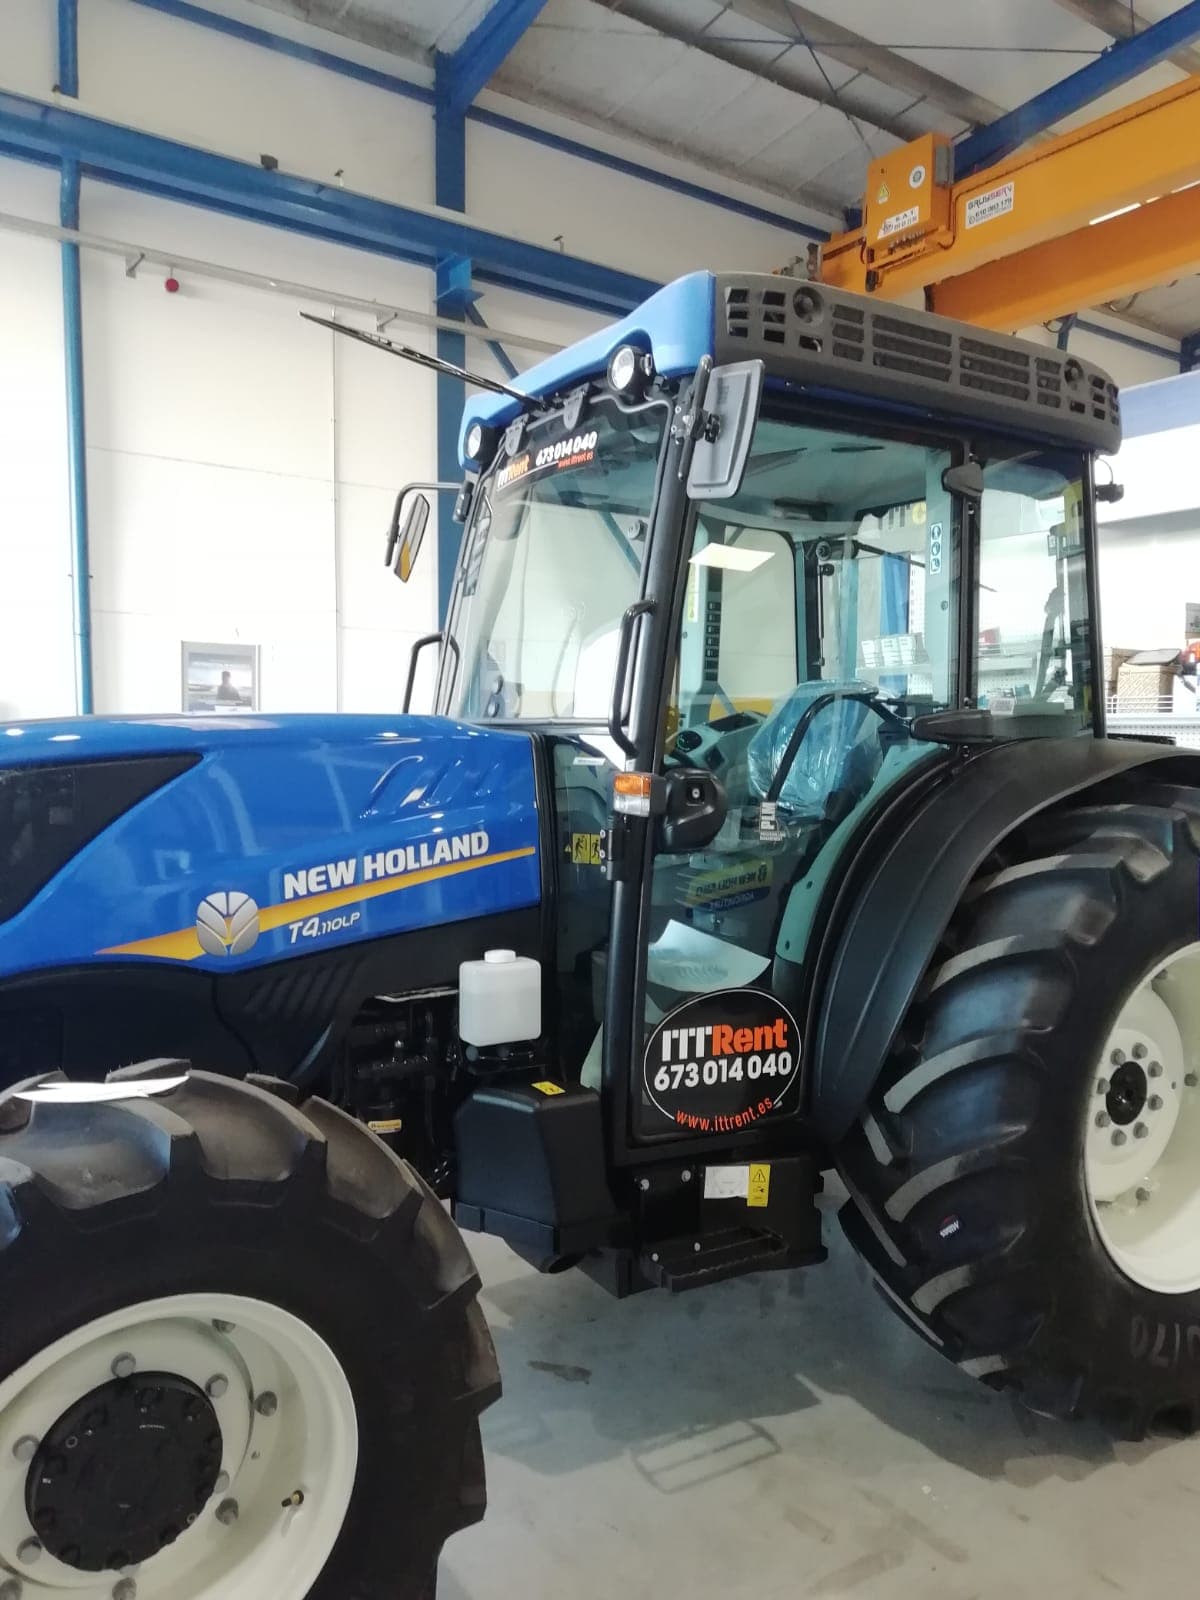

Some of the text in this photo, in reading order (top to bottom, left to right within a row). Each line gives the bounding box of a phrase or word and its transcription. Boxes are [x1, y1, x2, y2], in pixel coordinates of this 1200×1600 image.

[284, 831, 489, 899] NEW HOLLAND
[662, 1018, 788, 1062] ITTRent
[654, 1051, 792, 1091] 673 014 040
[676, 1097, 773, 1132] www.ittrent.es
